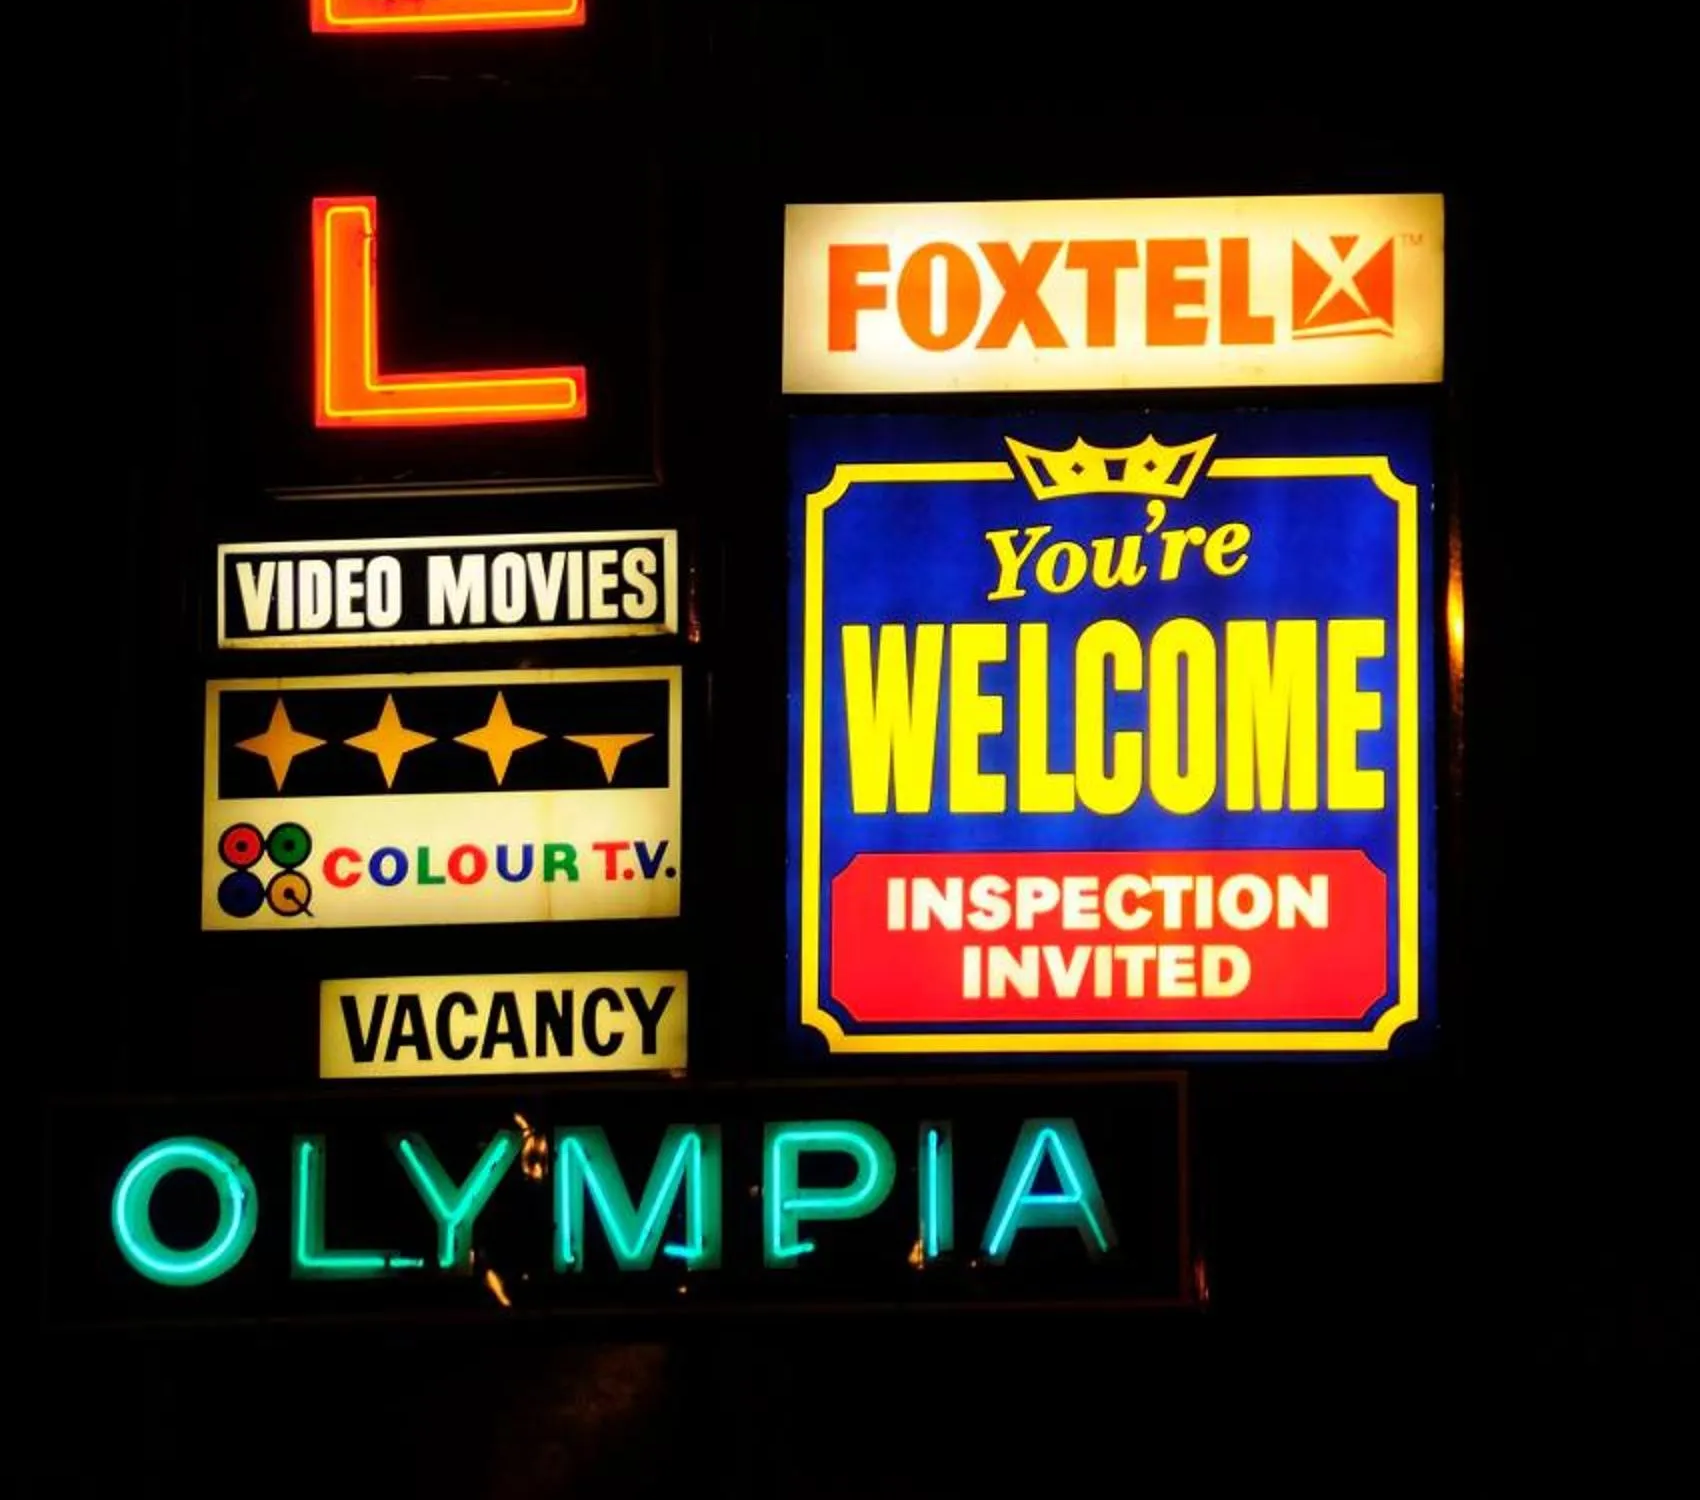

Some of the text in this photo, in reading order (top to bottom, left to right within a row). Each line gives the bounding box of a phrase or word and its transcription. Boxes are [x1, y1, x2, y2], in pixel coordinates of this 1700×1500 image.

[827, 237, 1275, 353] FOXTEL
[235, 547, 658, 631] VIDEO MOVIES
[985, 499, 1251, 601] You're
[841, 617, 1386, 816] WELCOME
[322, 839, 677, 888] COLOUR T.V.
[886, 874, 1329, 932] INSPECTION
[961, 945, 1251, 1000] INVITED
[339, 986, 676, 1063] VACANCY
[111, 1118, 1120, 1288] OLYMPIA
